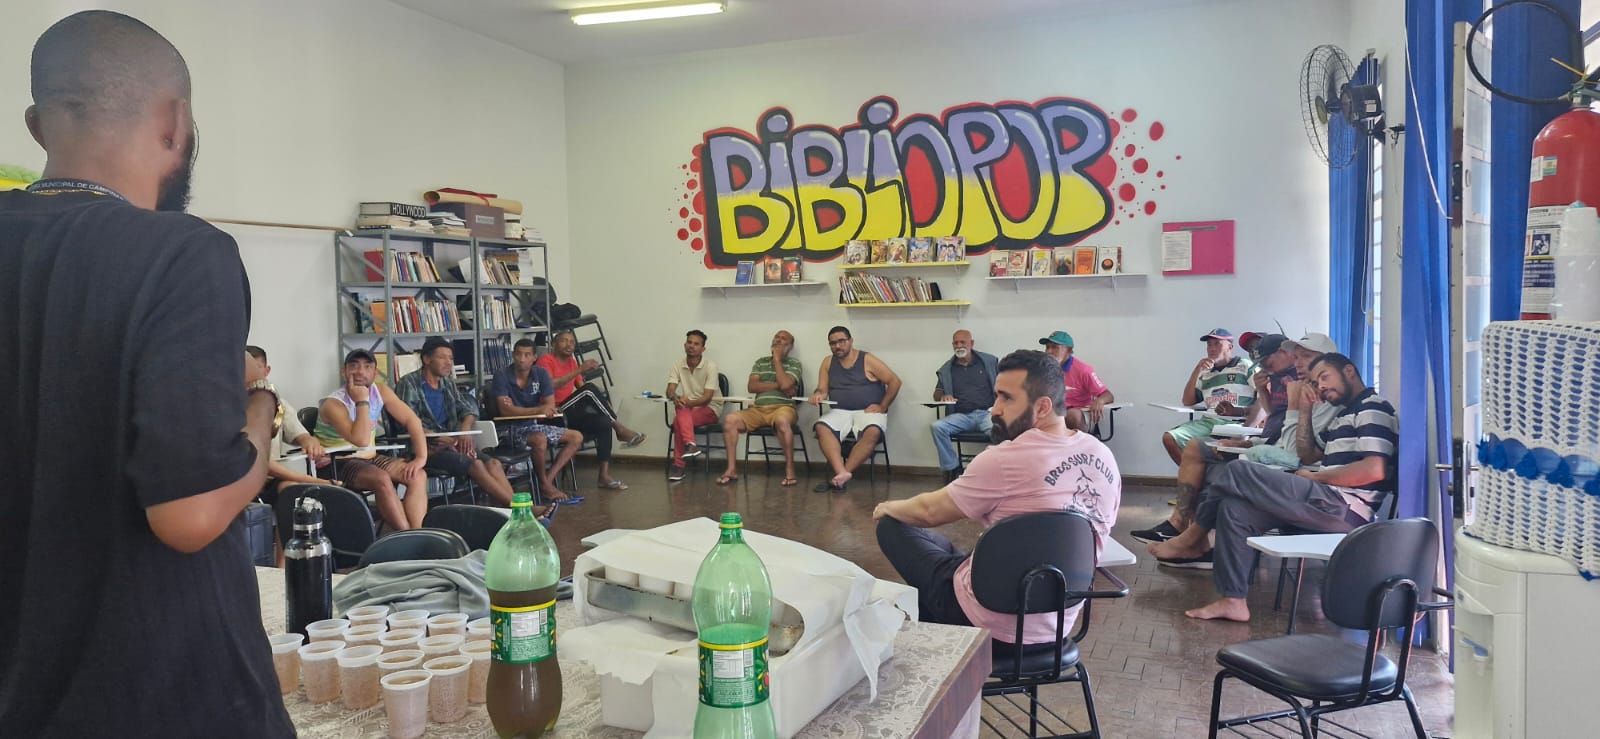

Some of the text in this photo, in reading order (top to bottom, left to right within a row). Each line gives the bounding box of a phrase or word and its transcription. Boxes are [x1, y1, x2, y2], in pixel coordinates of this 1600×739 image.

[392, 204, 426, 218] HOLLYWOOD
[1068, 453, 1095, 466] SURF
[1095, 458, 1114, 485] CLUB
